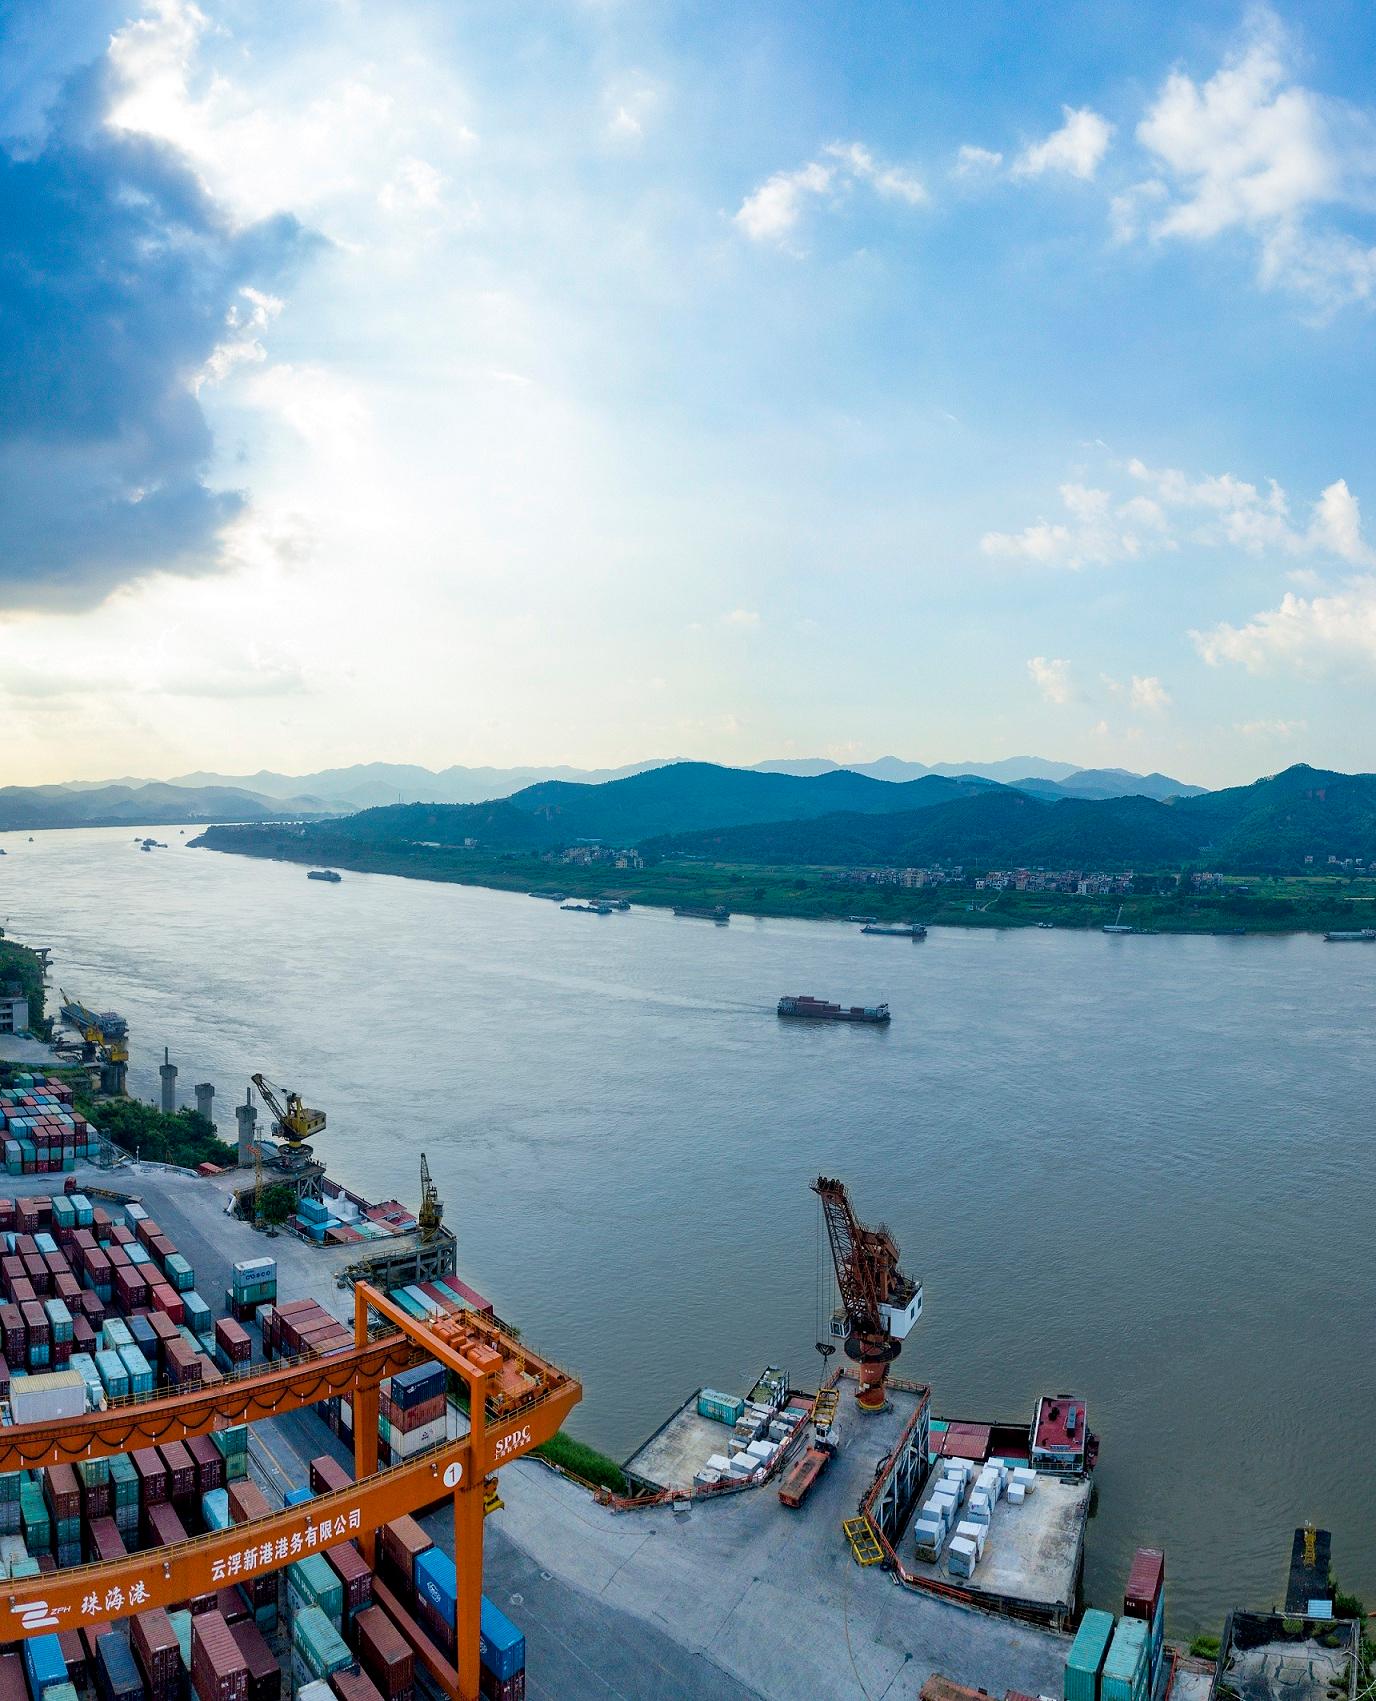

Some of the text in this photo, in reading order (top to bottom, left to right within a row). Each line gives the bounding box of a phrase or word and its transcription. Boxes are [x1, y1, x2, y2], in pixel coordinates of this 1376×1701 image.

[495, 1425, 531, 1453] SPDC
[448, 1466, 455, 1482] 1
[211, 1508, 361, 1582] 云浮新港港务有限公司
[50, 1605, 71, 1616] ZPH
[81, 1580, 150, 1616] 珠海港
